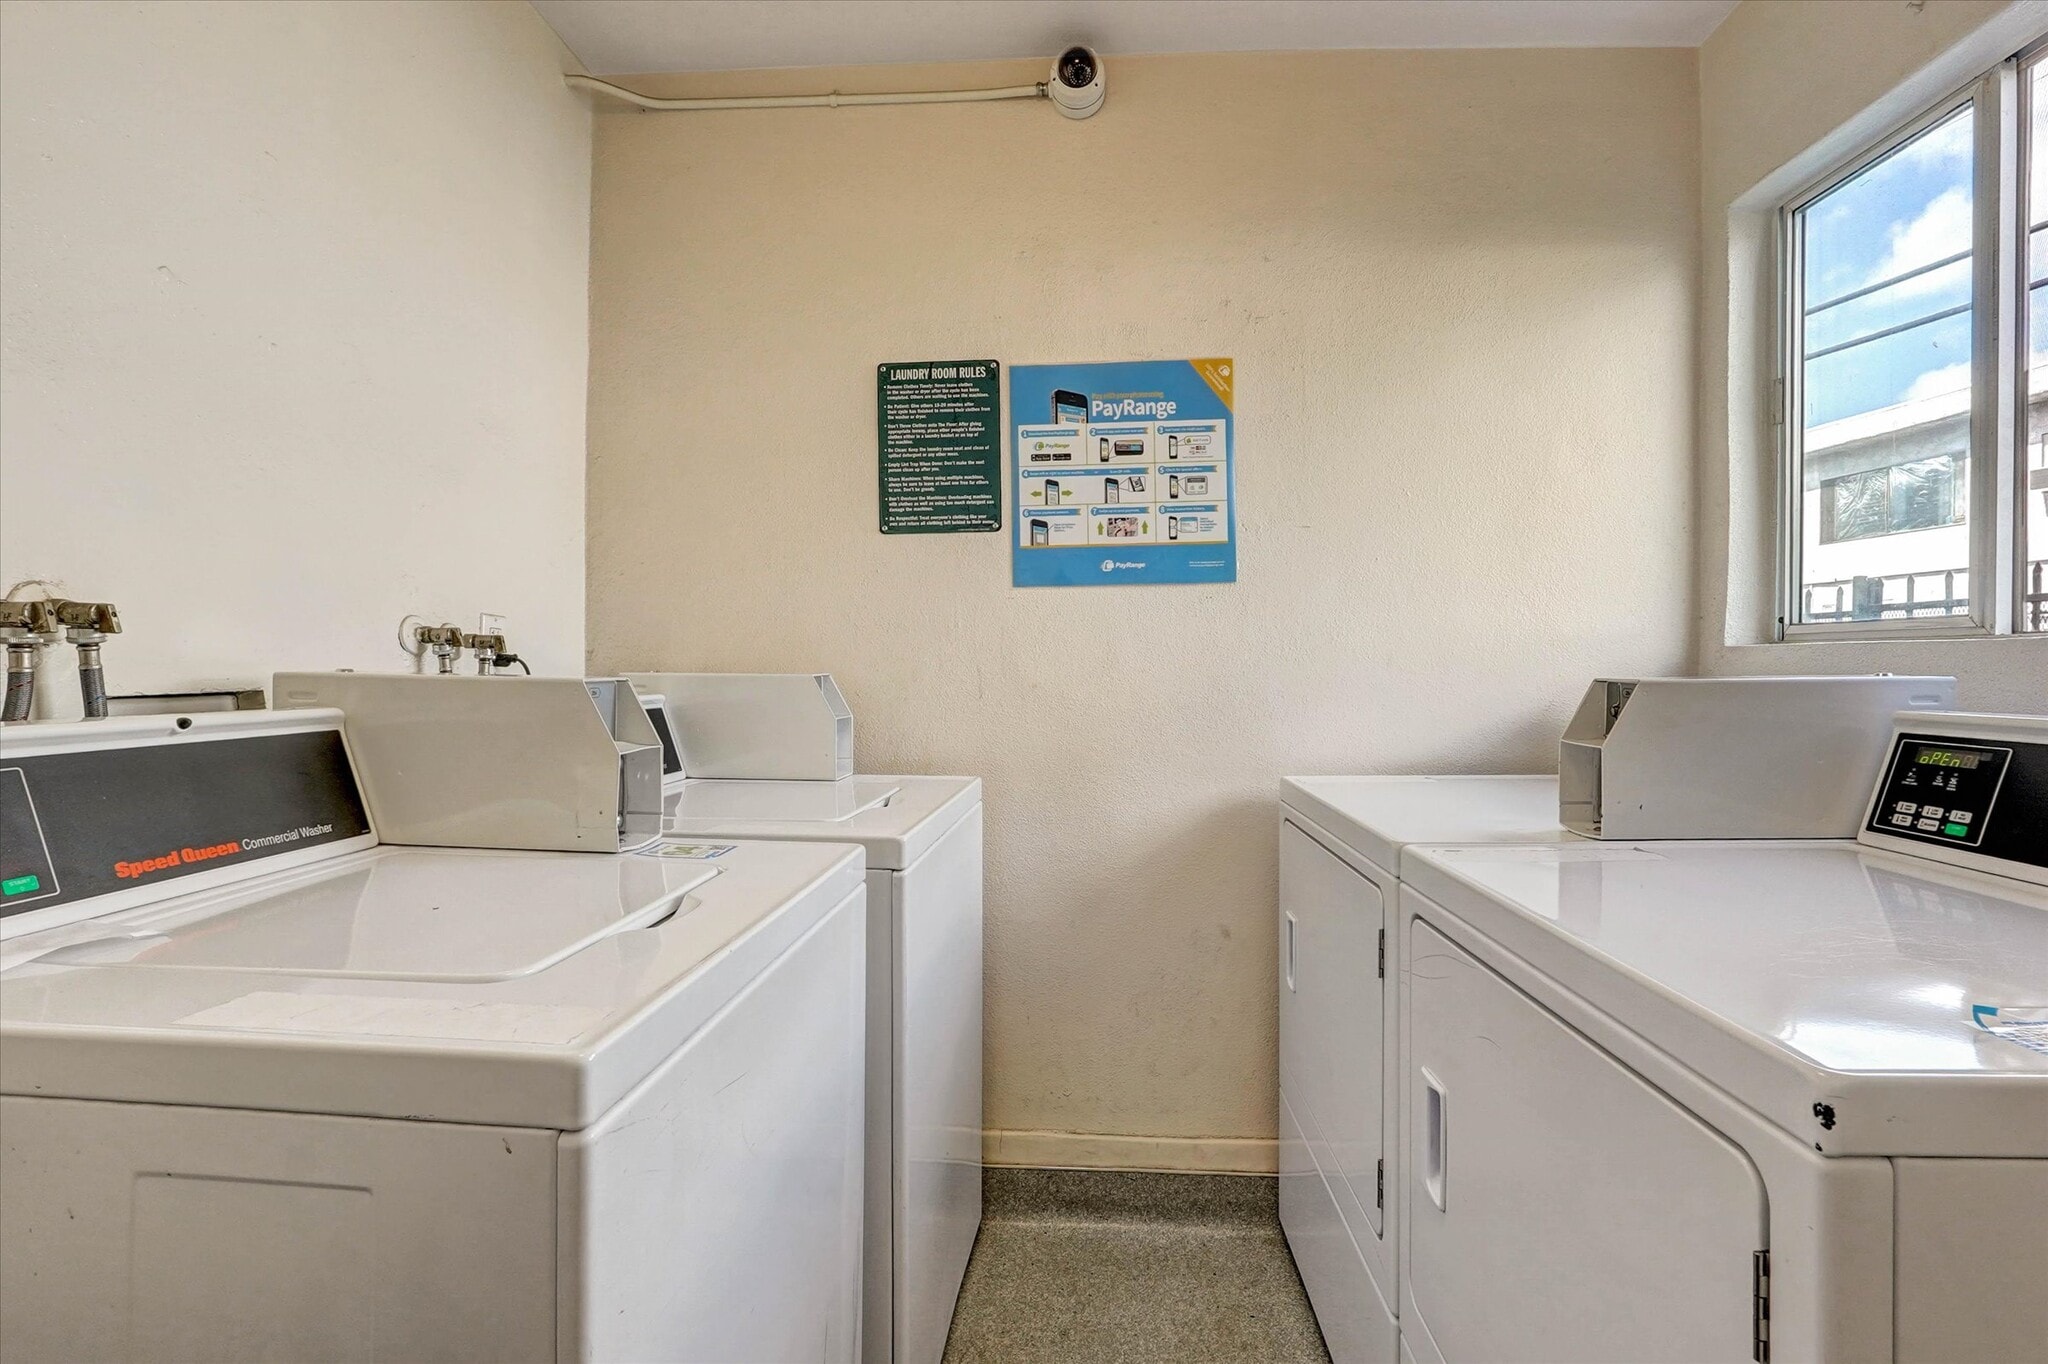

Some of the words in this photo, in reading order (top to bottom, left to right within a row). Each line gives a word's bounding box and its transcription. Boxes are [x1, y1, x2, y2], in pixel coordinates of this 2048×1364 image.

[891, 368, 929, 380] LAUNDRY
[932, 367, 957, 379] ROOM
[959, 366, 986, 378] RULES
[1092, 399, 1176, 419] PayRange
[114, 852, 180, 878] Speed
[181, 840, 241, 863] Queen
[242, 829, 299, 850] Commercial
[300, 822, 333, 838] Washer
